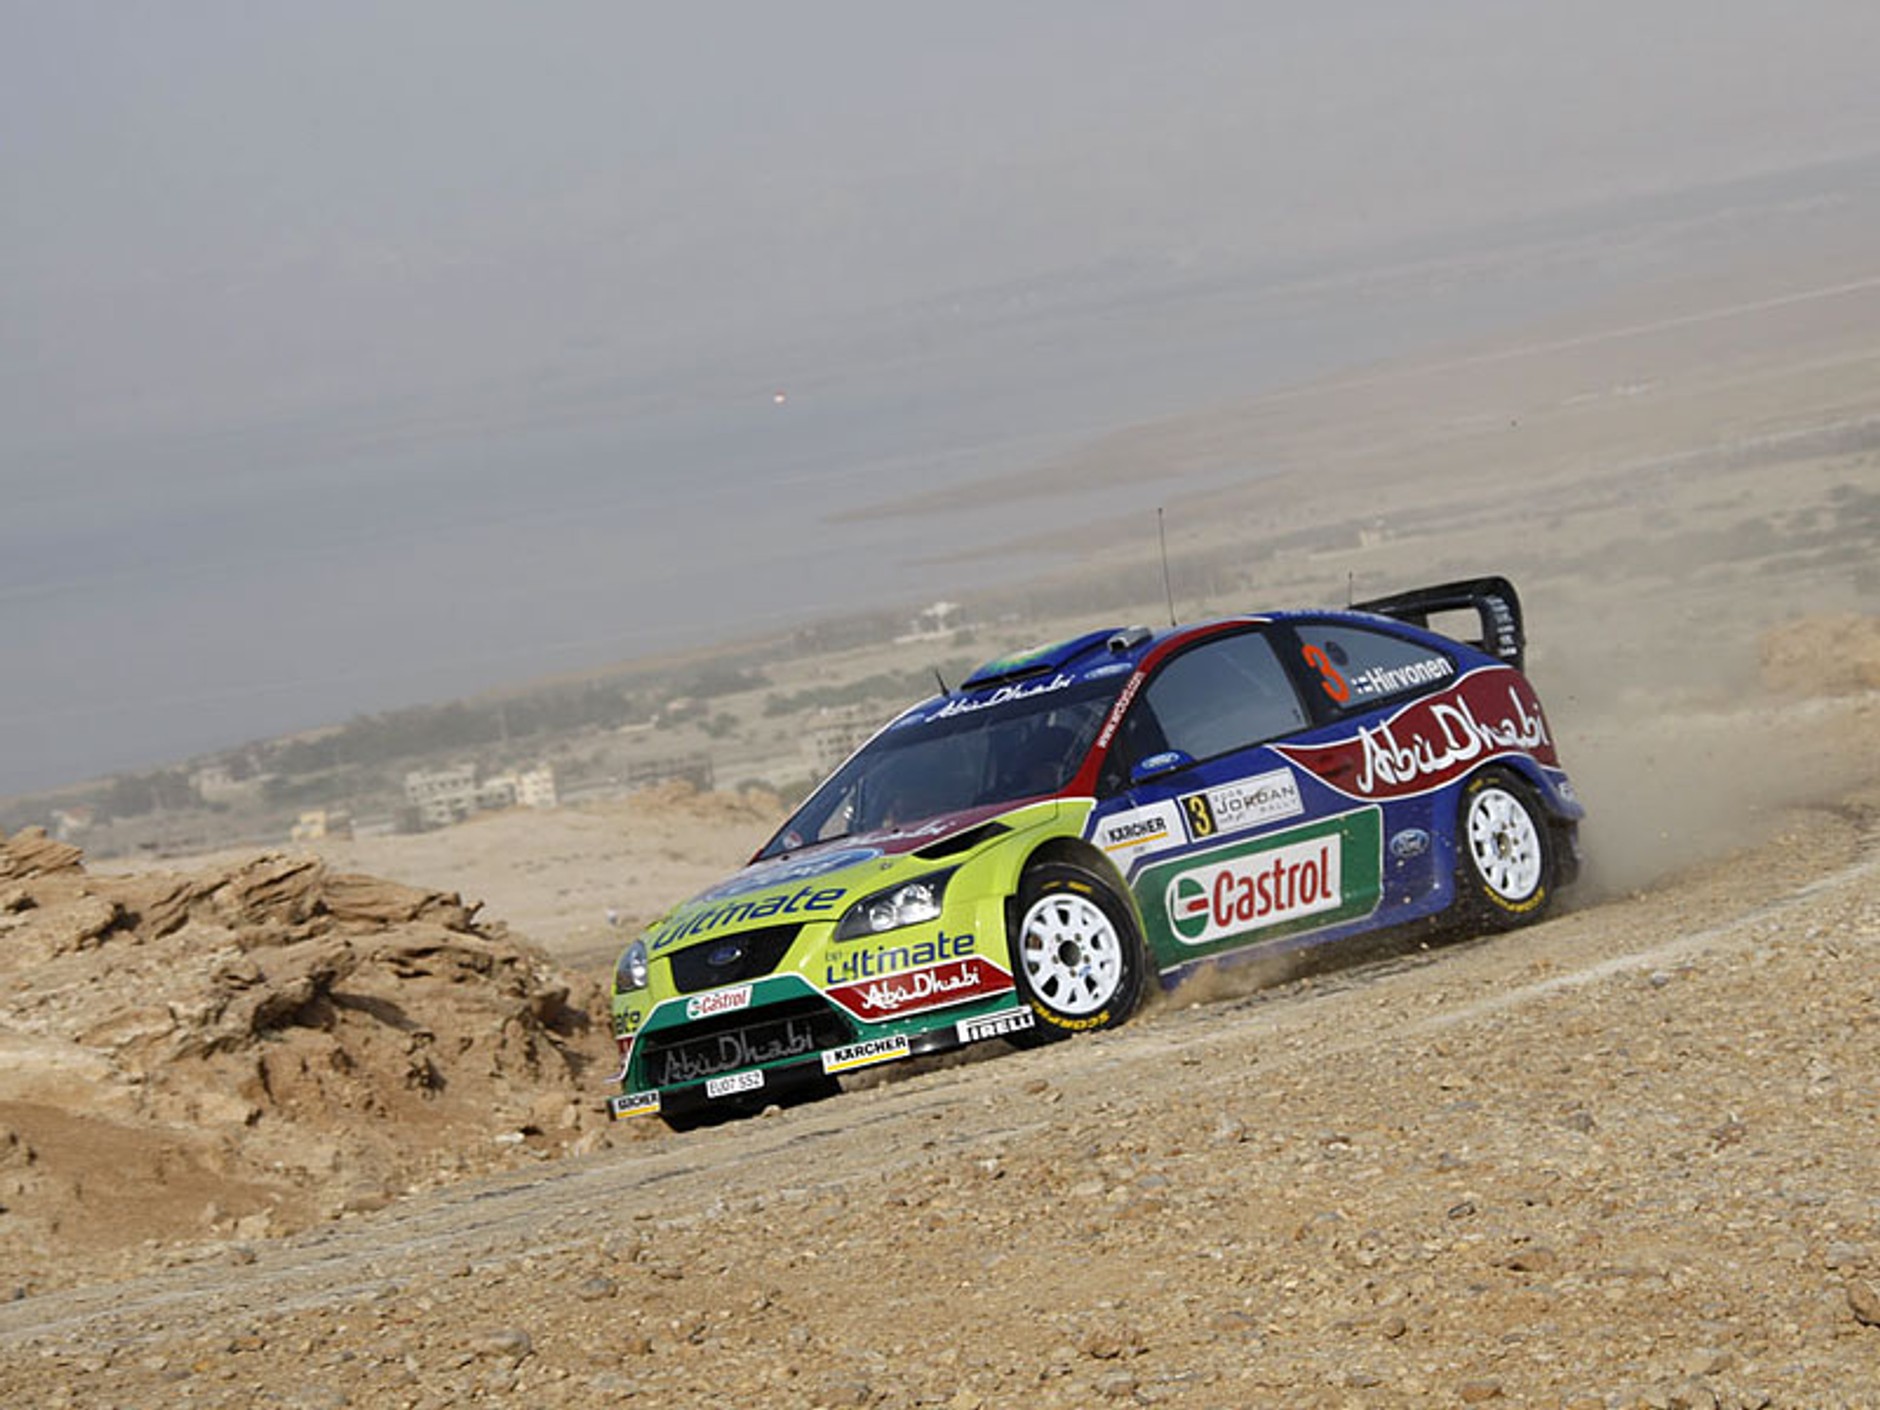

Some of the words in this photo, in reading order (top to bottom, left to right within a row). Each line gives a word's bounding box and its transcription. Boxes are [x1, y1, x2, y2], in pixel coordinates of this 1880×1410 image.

[1302, 644, 1350, 702] 3
[1365, 656, 1454, 694] Hirvonen
[1356, 720, 1443, 794] Abu
[1430, 686, 1550, 761] Dhabi
[1189, 796, 1212, 836] 3
[1217, 785, 1295, 815] JORDAN
[1213, 846, 1332, 928] Castrol
[652, 886, 848, 950] ultimate
[826, 931, 975, 984] ultimate
[702, 989, 747, 1014] Castrol
[861, 981, 912, 1010] Abu
[912, 963, 981, 1001] Dhabi
[957, 1005, 1034, 1043] PIRELLI
[659, 1051, 712, 1087] Abu
[717, 1020, 815, 1068] Dhabi
